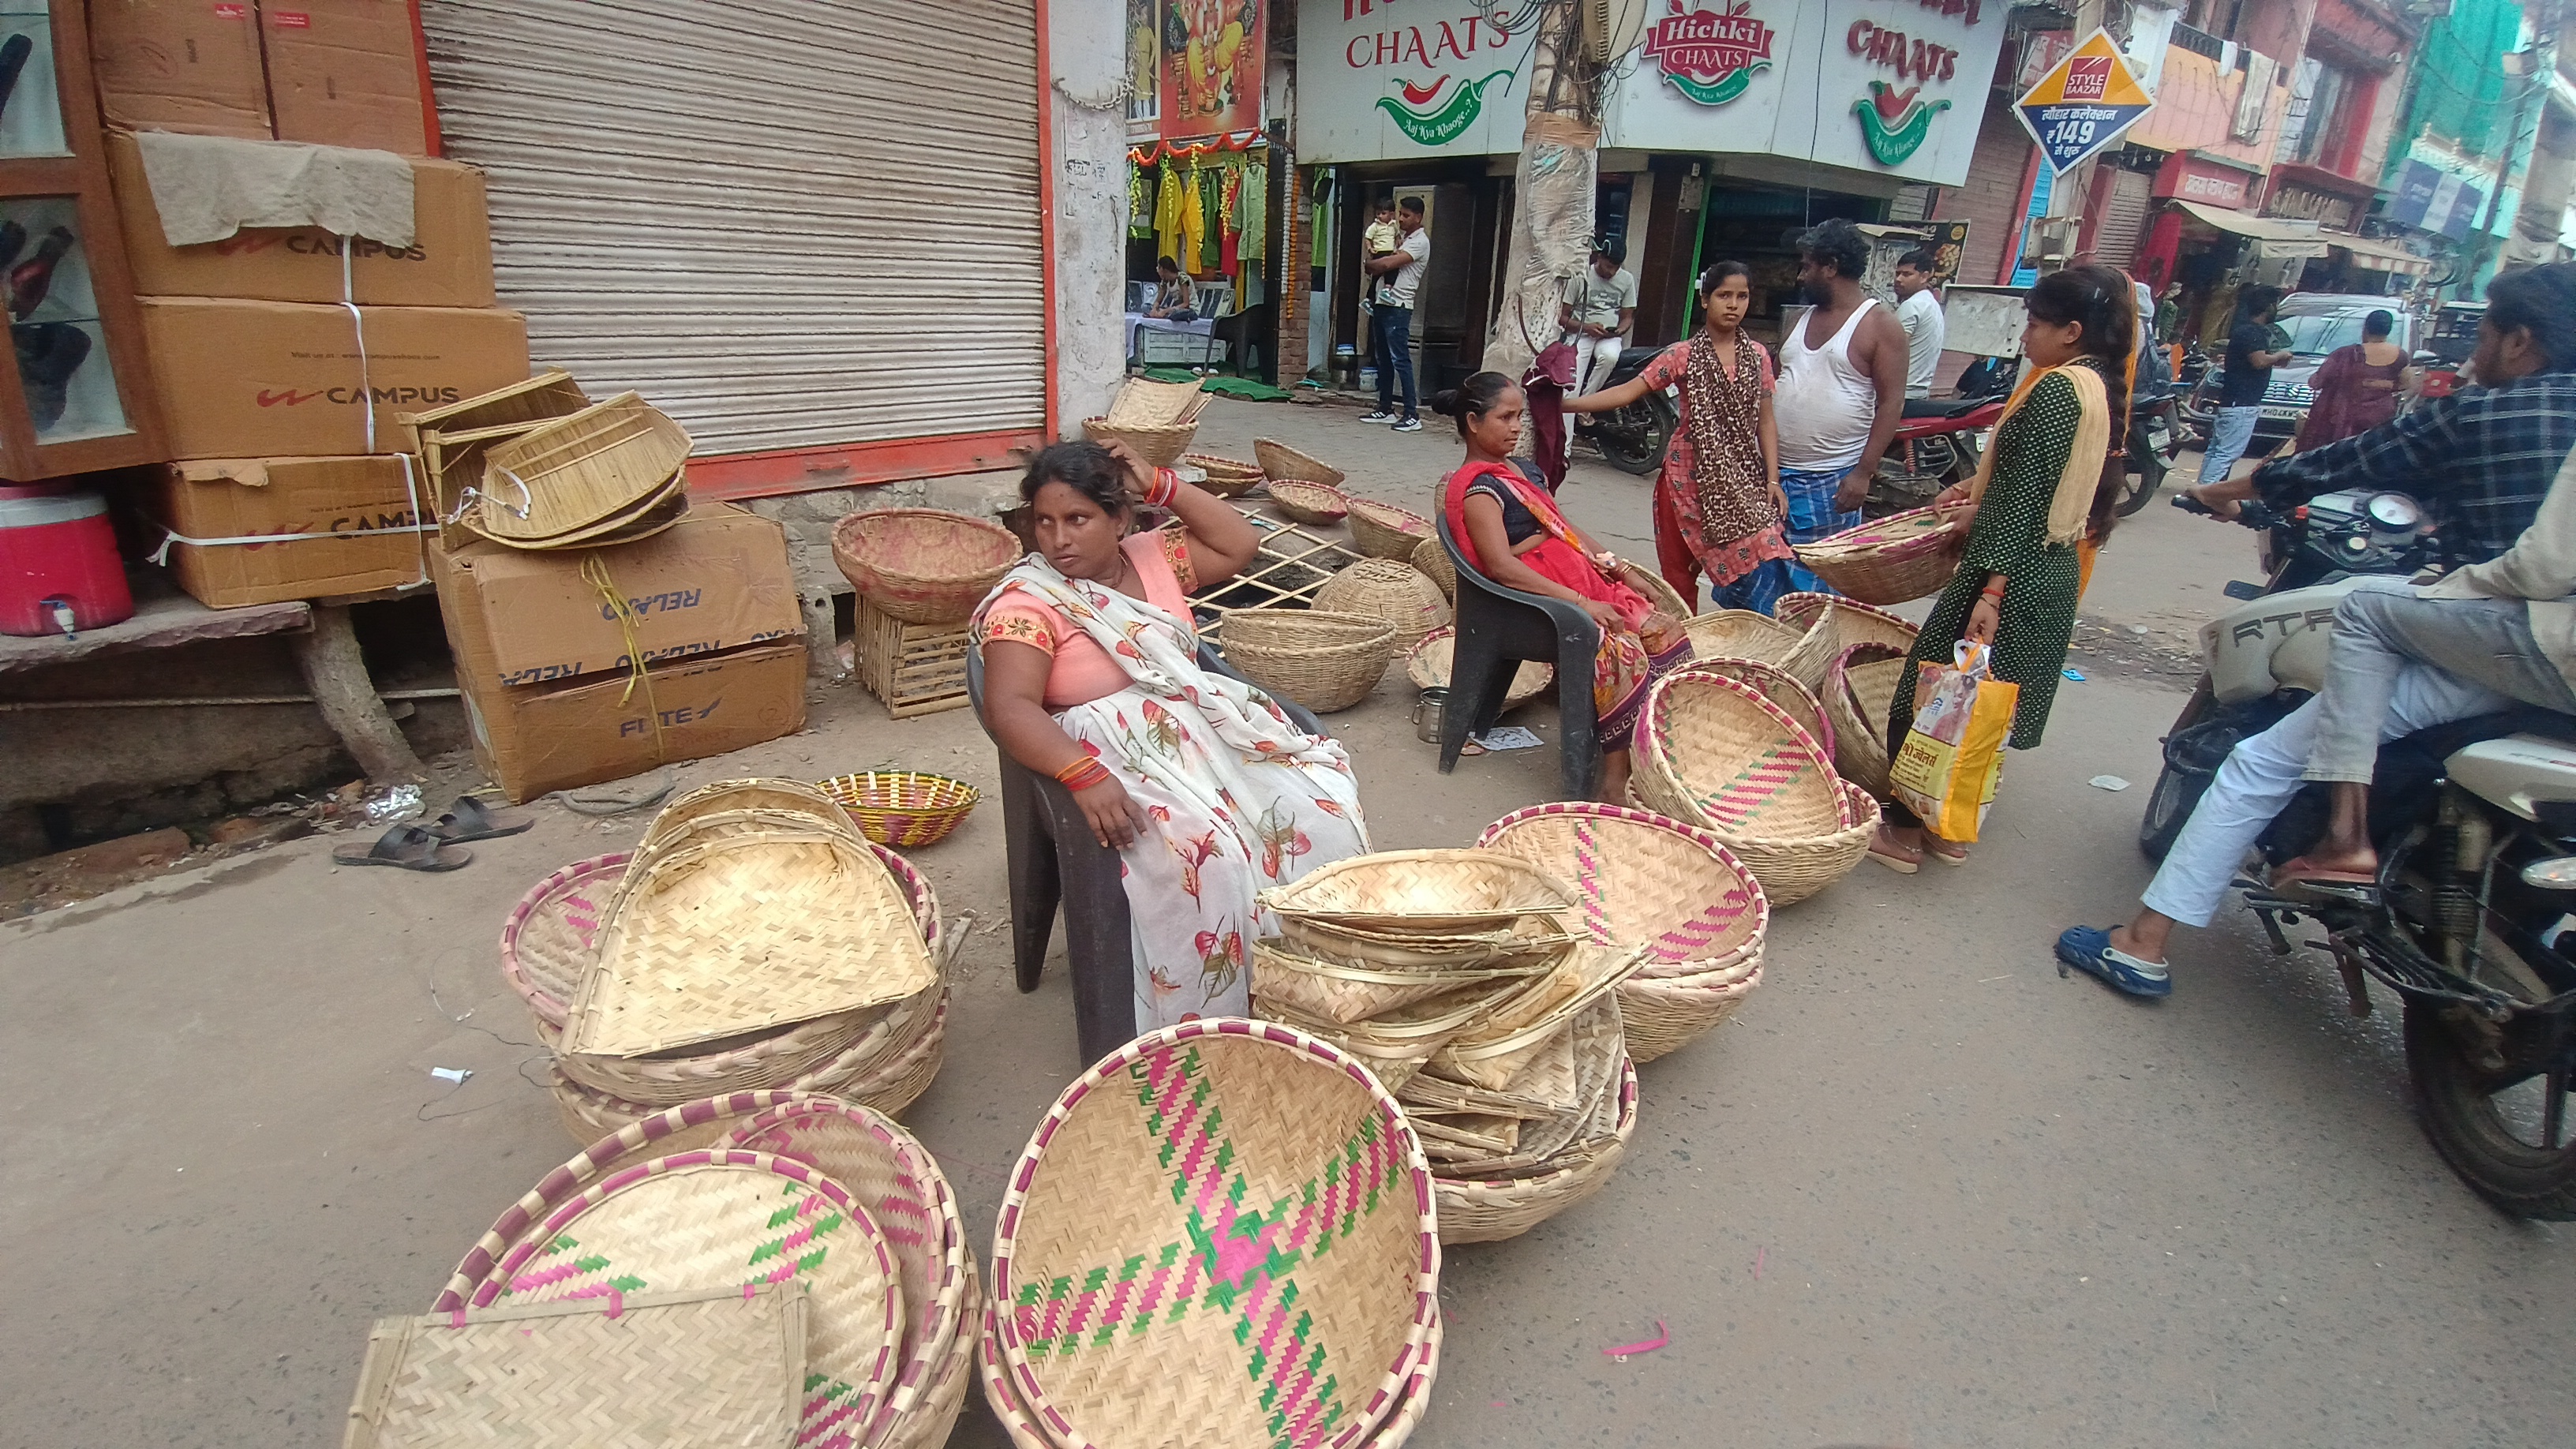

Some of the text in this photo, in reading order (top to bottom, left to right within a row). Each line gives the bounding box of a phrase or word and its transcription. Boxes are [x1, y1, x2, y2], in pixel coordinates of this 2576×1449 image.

[1346, 11, 1509, 68] CHAATS
[1667, 19, 1756, 43] Hichki
[1672, 49, 1742, 69] CHAATS
[1848, 20, 1959, 81] CHAATS
[2068, 74, 2105, 86] STYLE
[2065, 85, 2101, 95] BAAZAR
[2069, 105, 2118, 121] कलेक्शन
[1403, 119, 1418, 137] Aaj
[2046, 121, 2096, 144] ₹149
[2054, 145, 2064, 155] से
[287, 236, 427, 261] CAMPUS
[327, 387, 459, 404] CAMPUS
